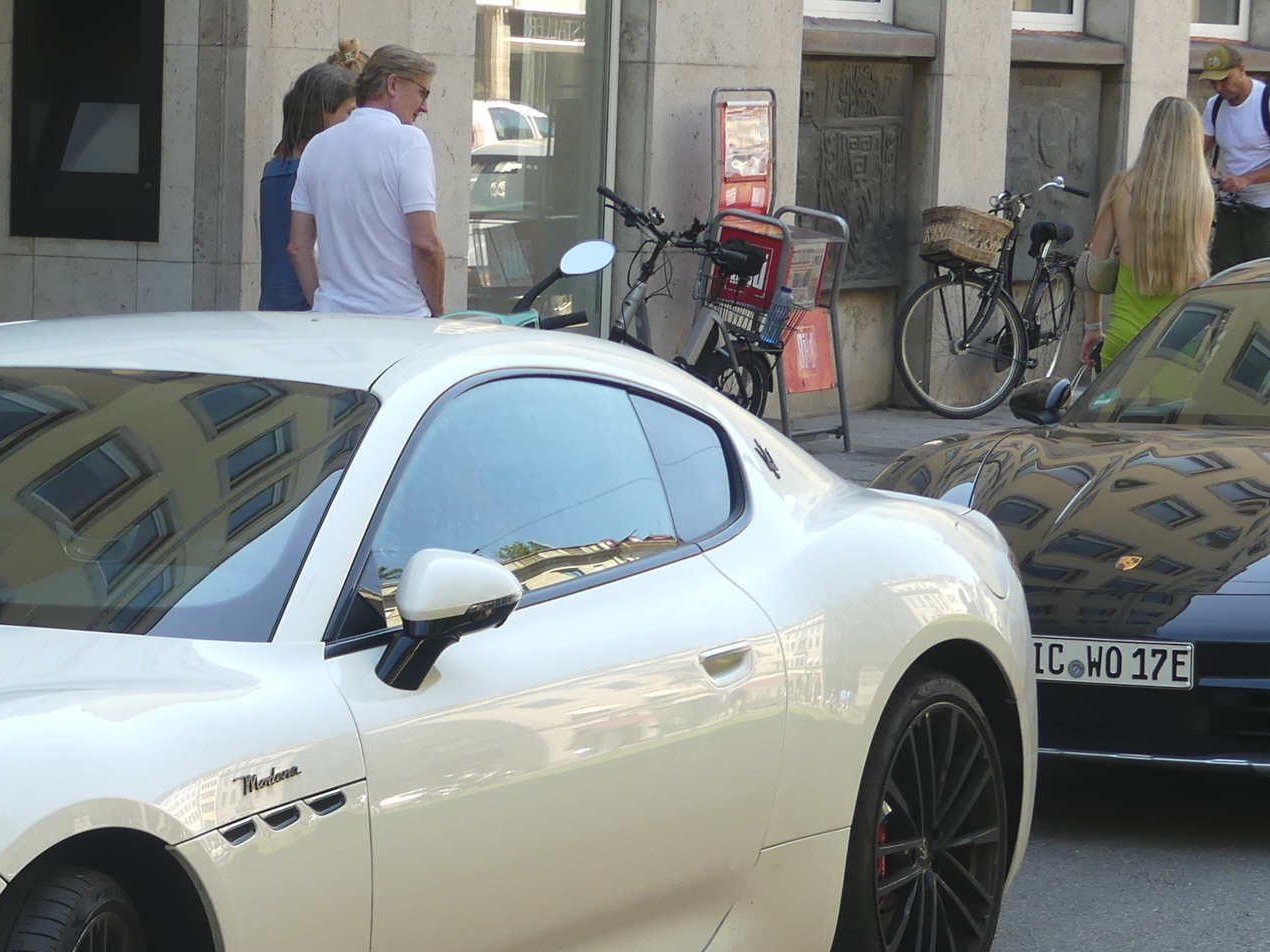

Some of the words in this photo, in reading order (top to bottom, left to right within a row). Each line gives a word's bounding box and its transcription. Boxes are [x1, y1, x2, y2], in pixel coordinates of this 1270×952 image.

[1086, 645, 1122, 679] WO
[1132, 648, 1189, 682] 17E
[232, 765, 302, 795] Modena
